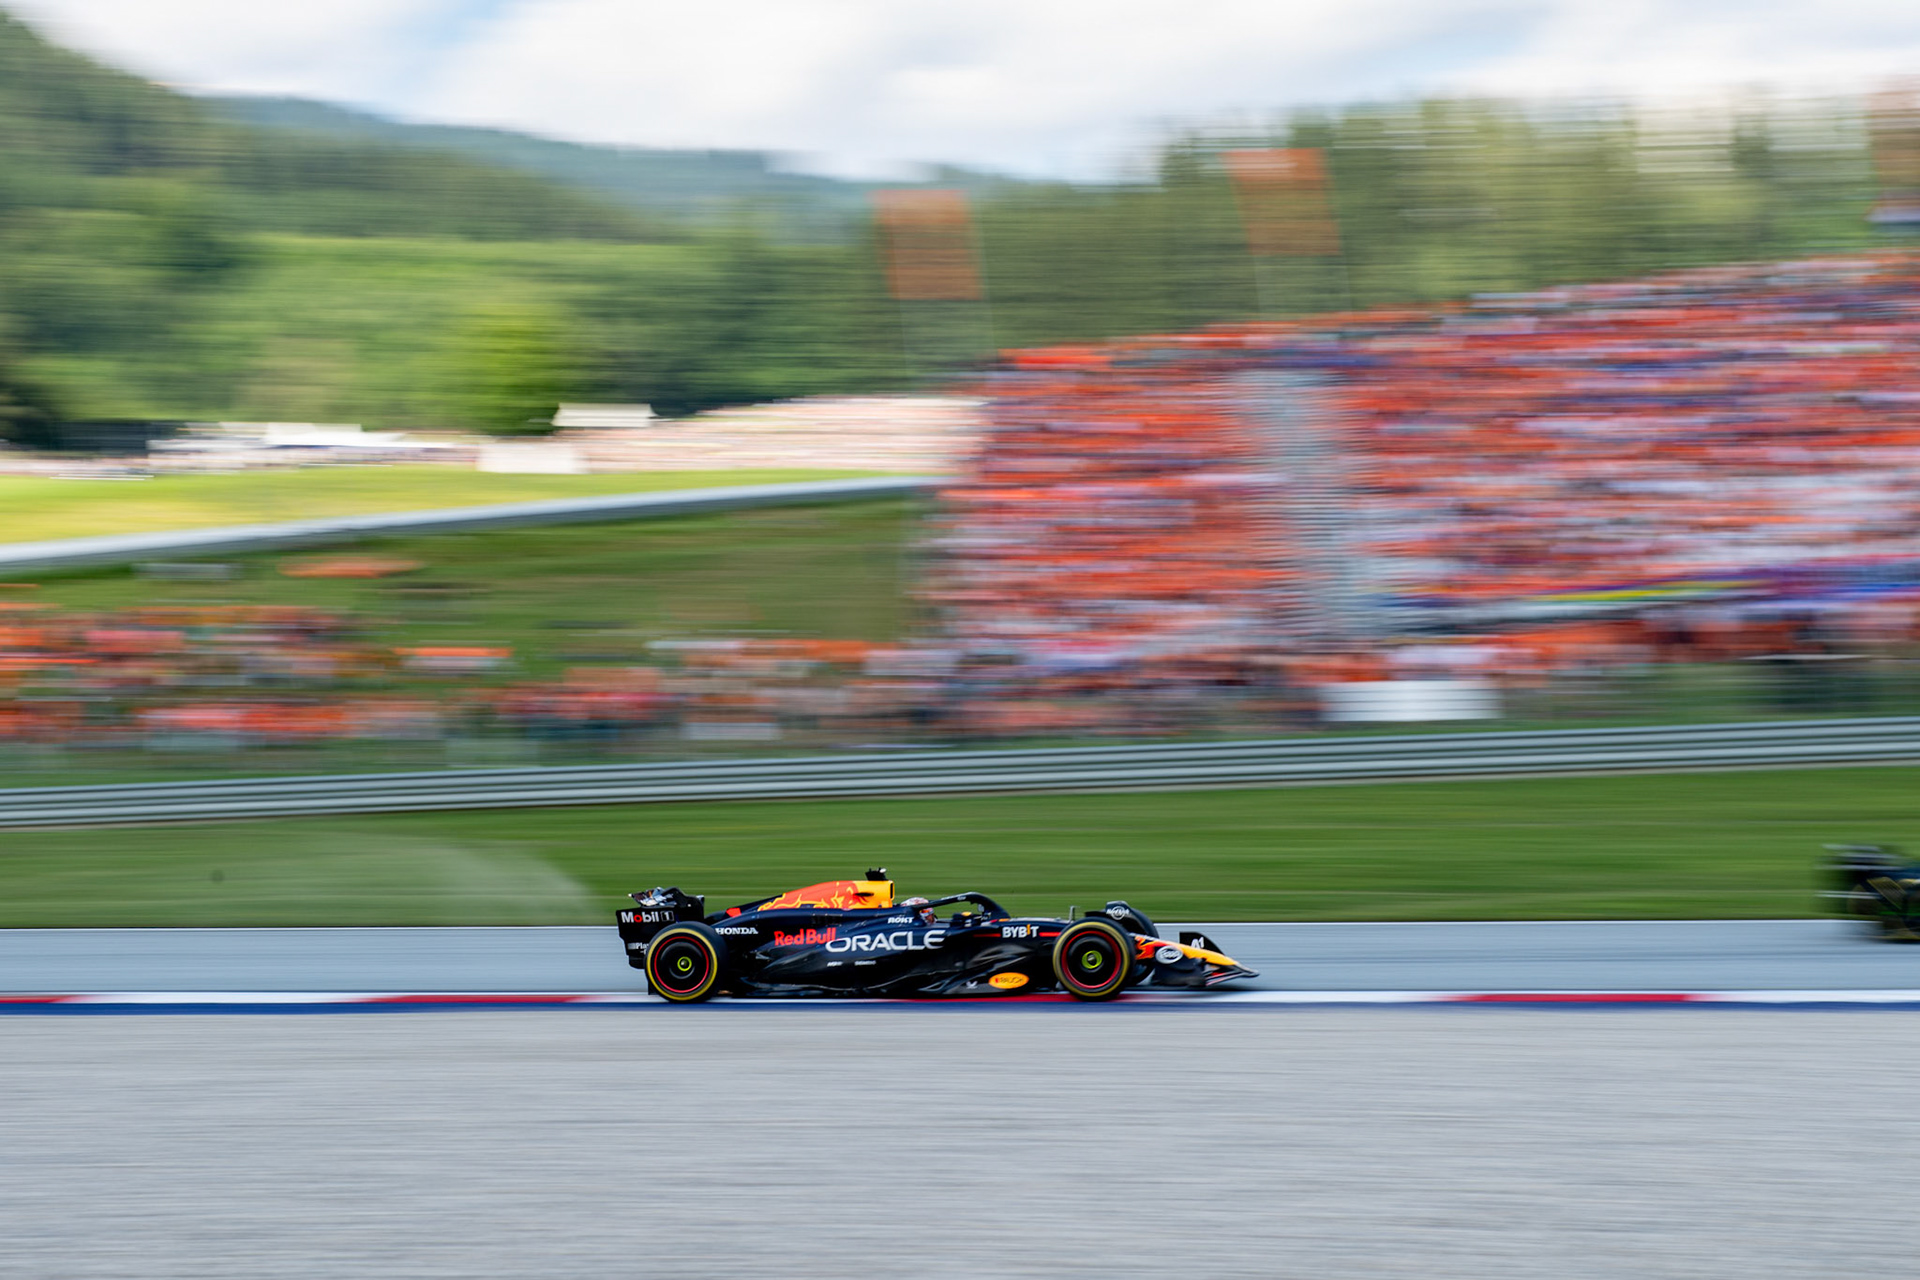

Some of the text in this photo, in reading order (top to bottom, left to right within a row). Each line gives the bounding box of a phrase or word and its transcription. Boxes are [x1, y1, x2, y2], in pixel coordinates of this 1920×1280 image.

[621, 911, 659, 923] Mobil
[715, 927, 759, 935] HONDA
[825, 929, 946, 953] ORACLE
